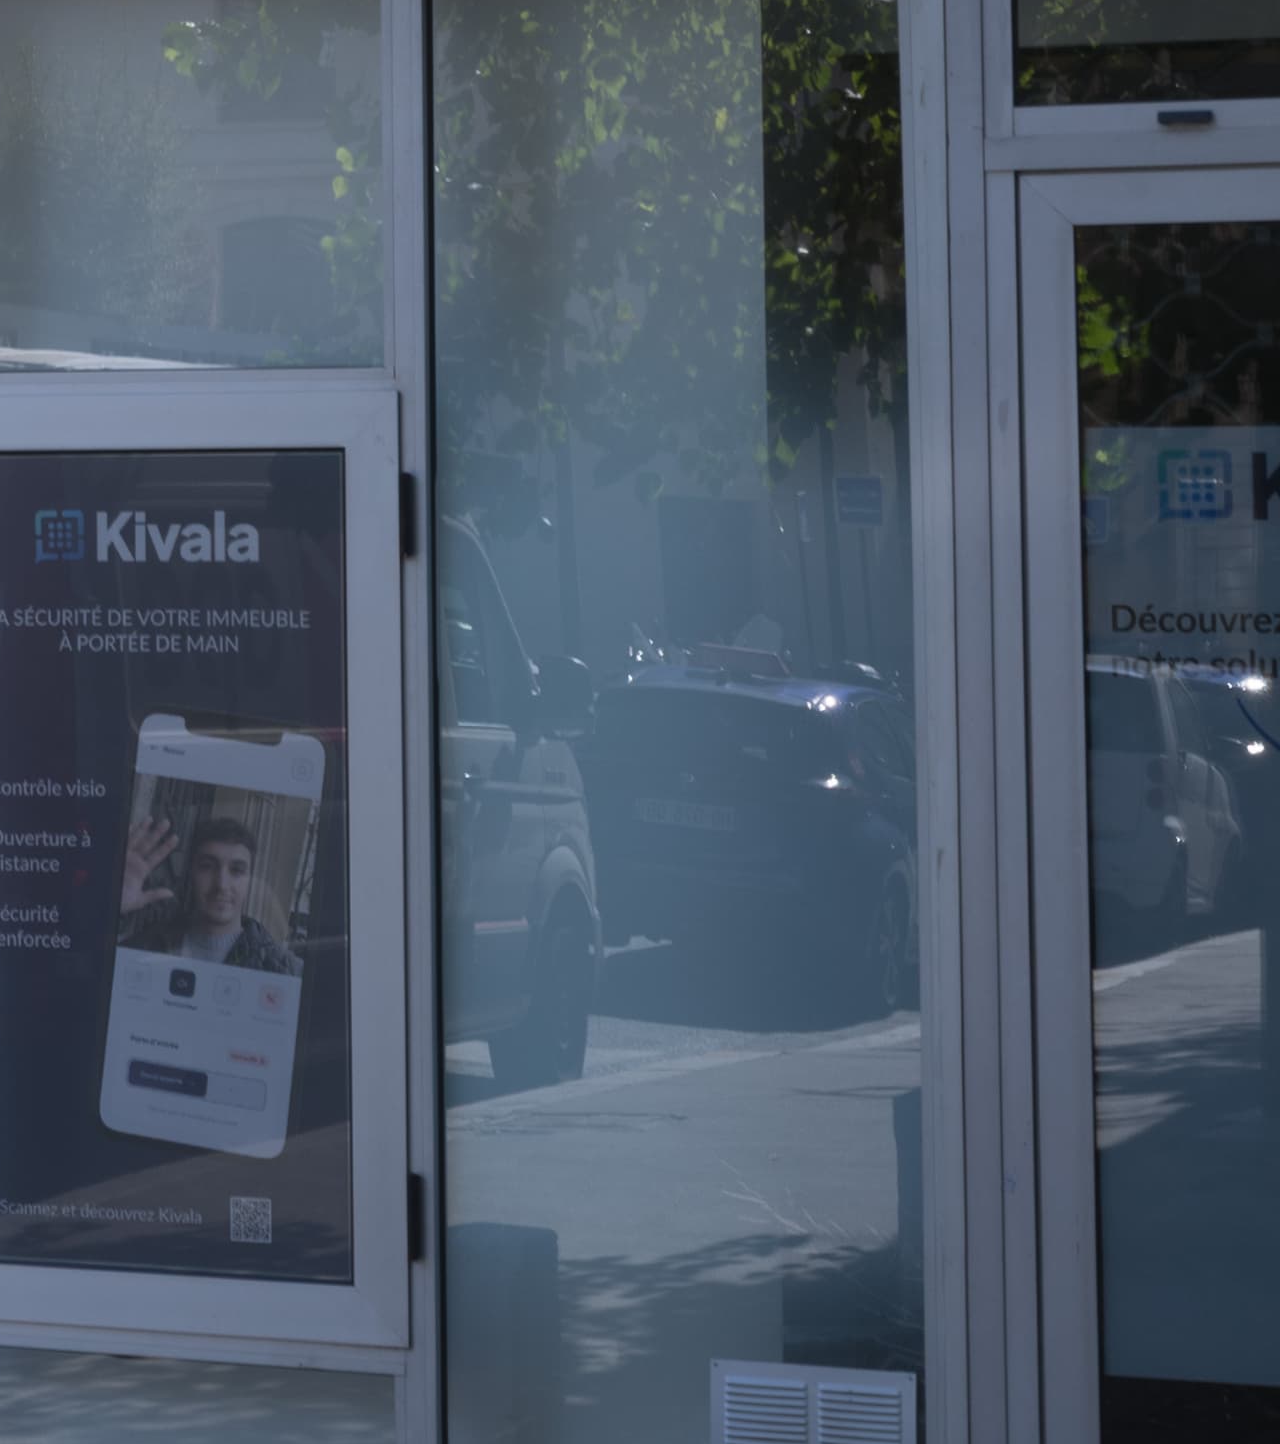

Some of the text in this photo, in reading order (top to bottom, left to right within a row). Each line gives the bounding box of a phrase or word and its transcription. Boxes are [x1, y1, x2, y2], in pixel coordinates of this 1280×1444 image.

[96, 510, 260, 563] Kivala
[14, 605, 101, 628] SÉCURITÉ
[107, 609, 132, 628] DE
[135, 609, 200, 628] VOTRE
[206, 609, 311, 629] IMMEUBLE
[59, 629, 239, 654] À PORTÉE DE MAIN
[66, 779, 106, 798] visio
[81, 829, 92, 848] à
[0, 1198, 203, 1225] Scannez et découvrez Kivala
